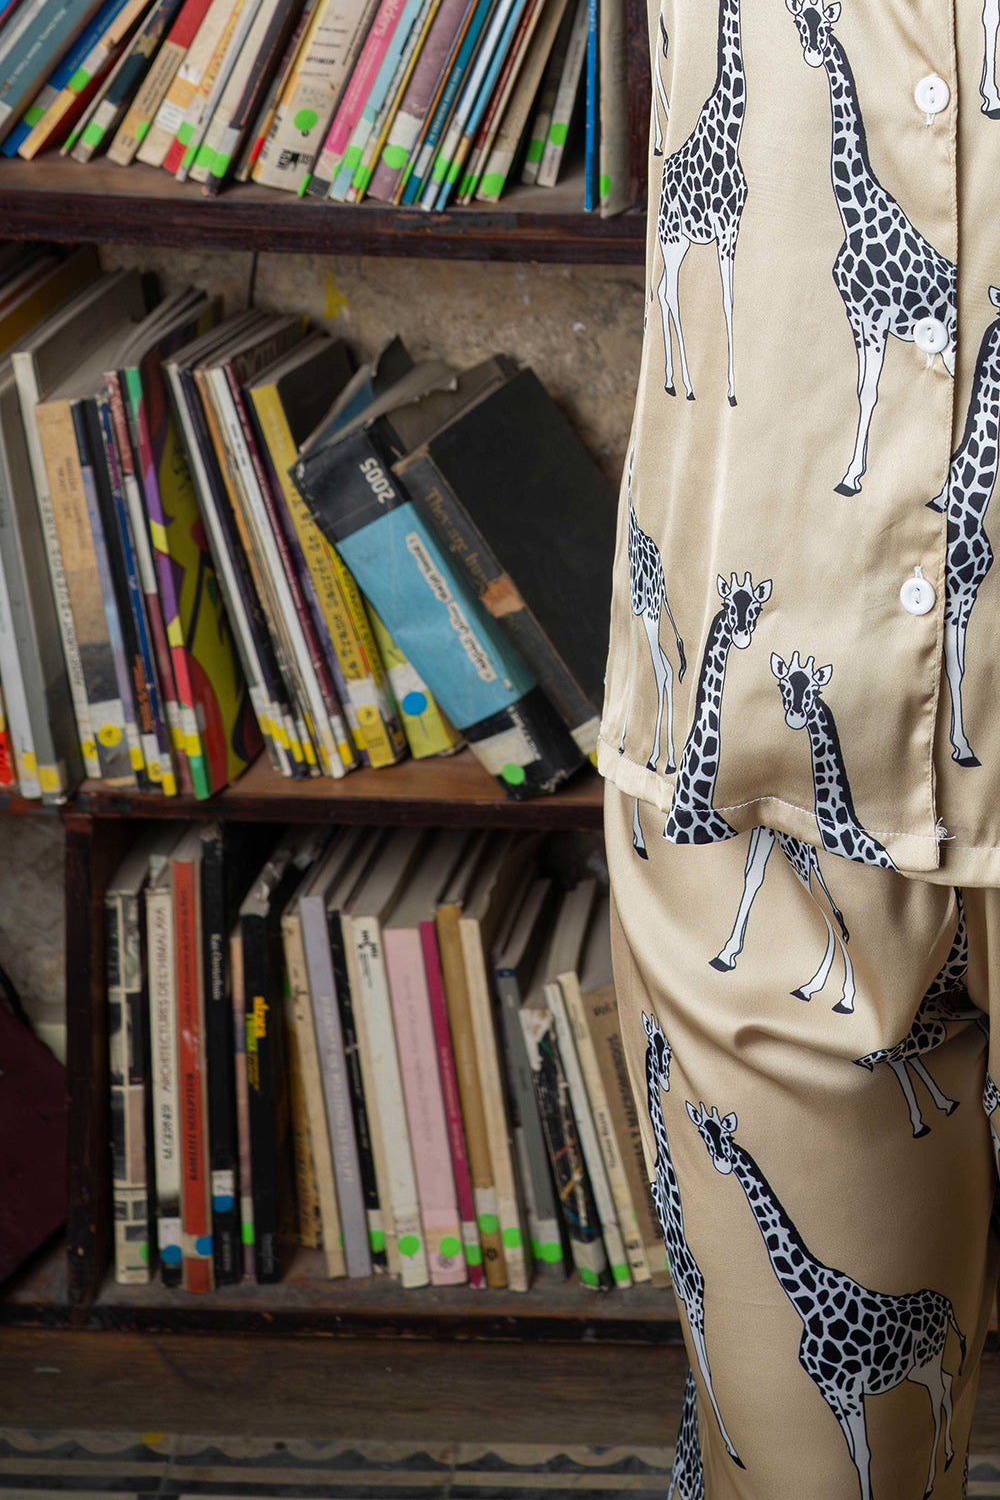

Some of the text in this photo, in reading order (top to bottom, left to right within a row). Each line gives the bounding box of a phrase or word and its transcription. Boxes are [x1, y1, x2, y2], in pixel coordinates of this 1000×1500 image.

[355, 453, 398, 505] 2005
[155, 978, 168, 997] DE
[156, 997, 171, 1093] ARCHITECTURES
